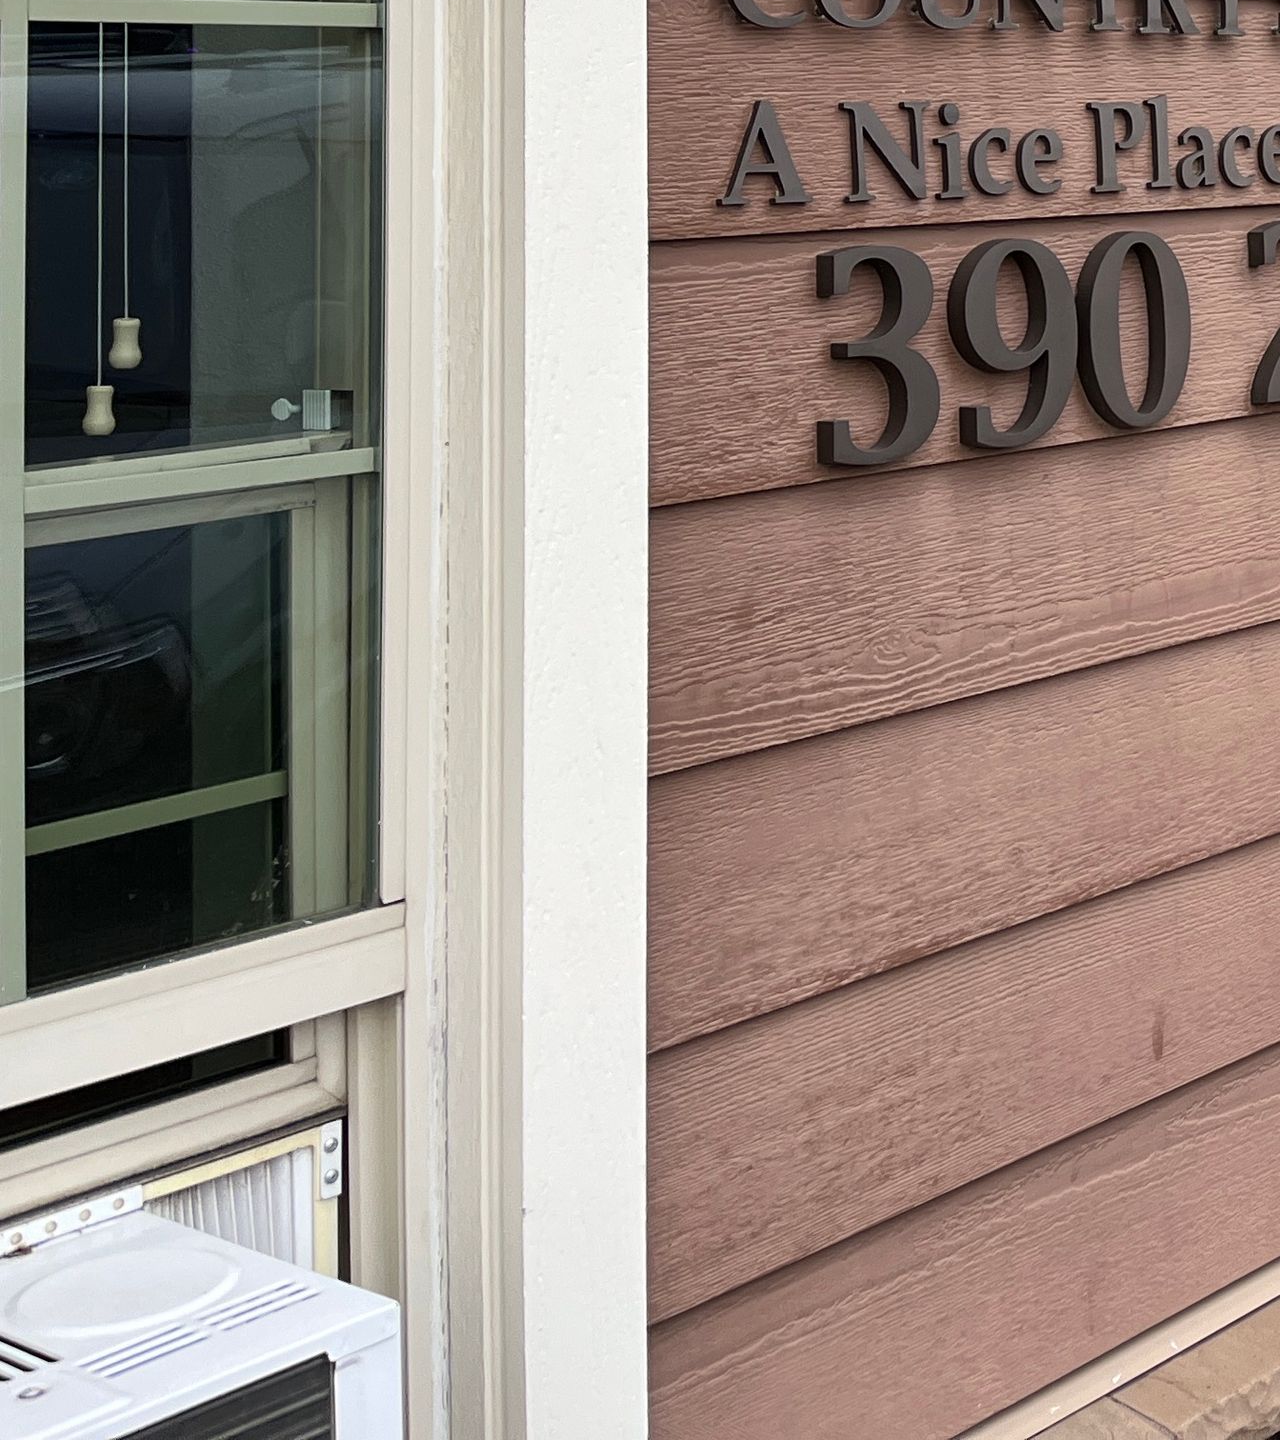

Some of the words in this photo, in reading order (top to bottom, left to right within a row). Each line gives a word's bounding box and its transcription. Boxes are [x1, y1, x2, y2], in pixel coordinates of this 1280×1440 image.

[717, 99, 812, 207] A
[838, 99, 1063, 204] Nice
[815, 230, 1192, 467] 390
